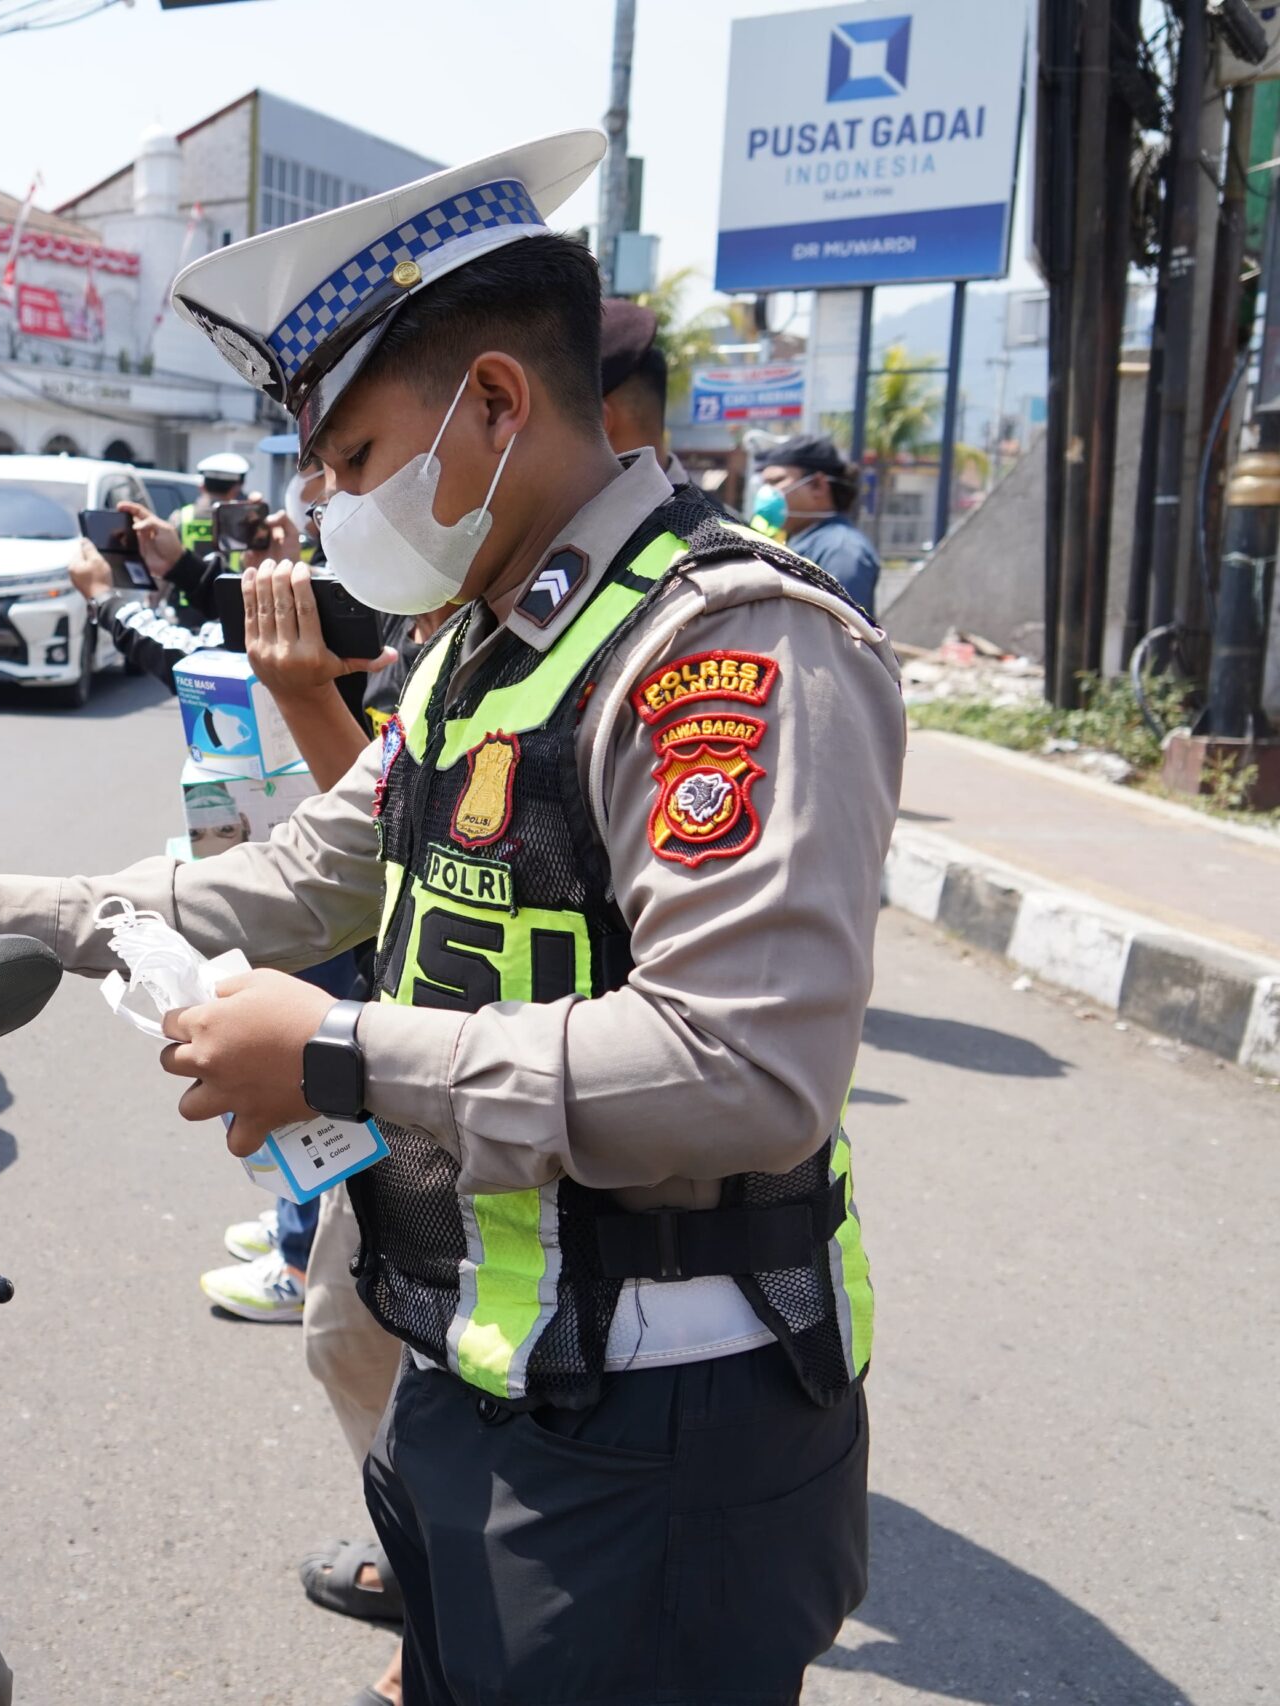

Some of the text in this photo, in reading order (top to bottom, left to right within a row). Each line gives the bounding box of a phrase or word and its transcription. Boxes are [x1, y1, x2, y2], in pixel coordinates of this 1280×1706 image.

[747, 105, 986, 160] PUSAT GADAI
[784, 153, 937, 187] INDONESIA
[791, 236, 917, 261] DR MUWARDI
[175, 675, 217, 692] FACE MASK
[644, 660, 760, 702] POLRES
[650, 675, 757, 711] CIANJUR
[662, 721, 701, 746] JAWA
[464, 814, 492, 827] POLISI
[429, 855, 506, 901] POLRI
[316, 1123, 336, 1137] Black
[323, 1132, 345, 1148] White
[329, 1143, 352, 1159] Colour
